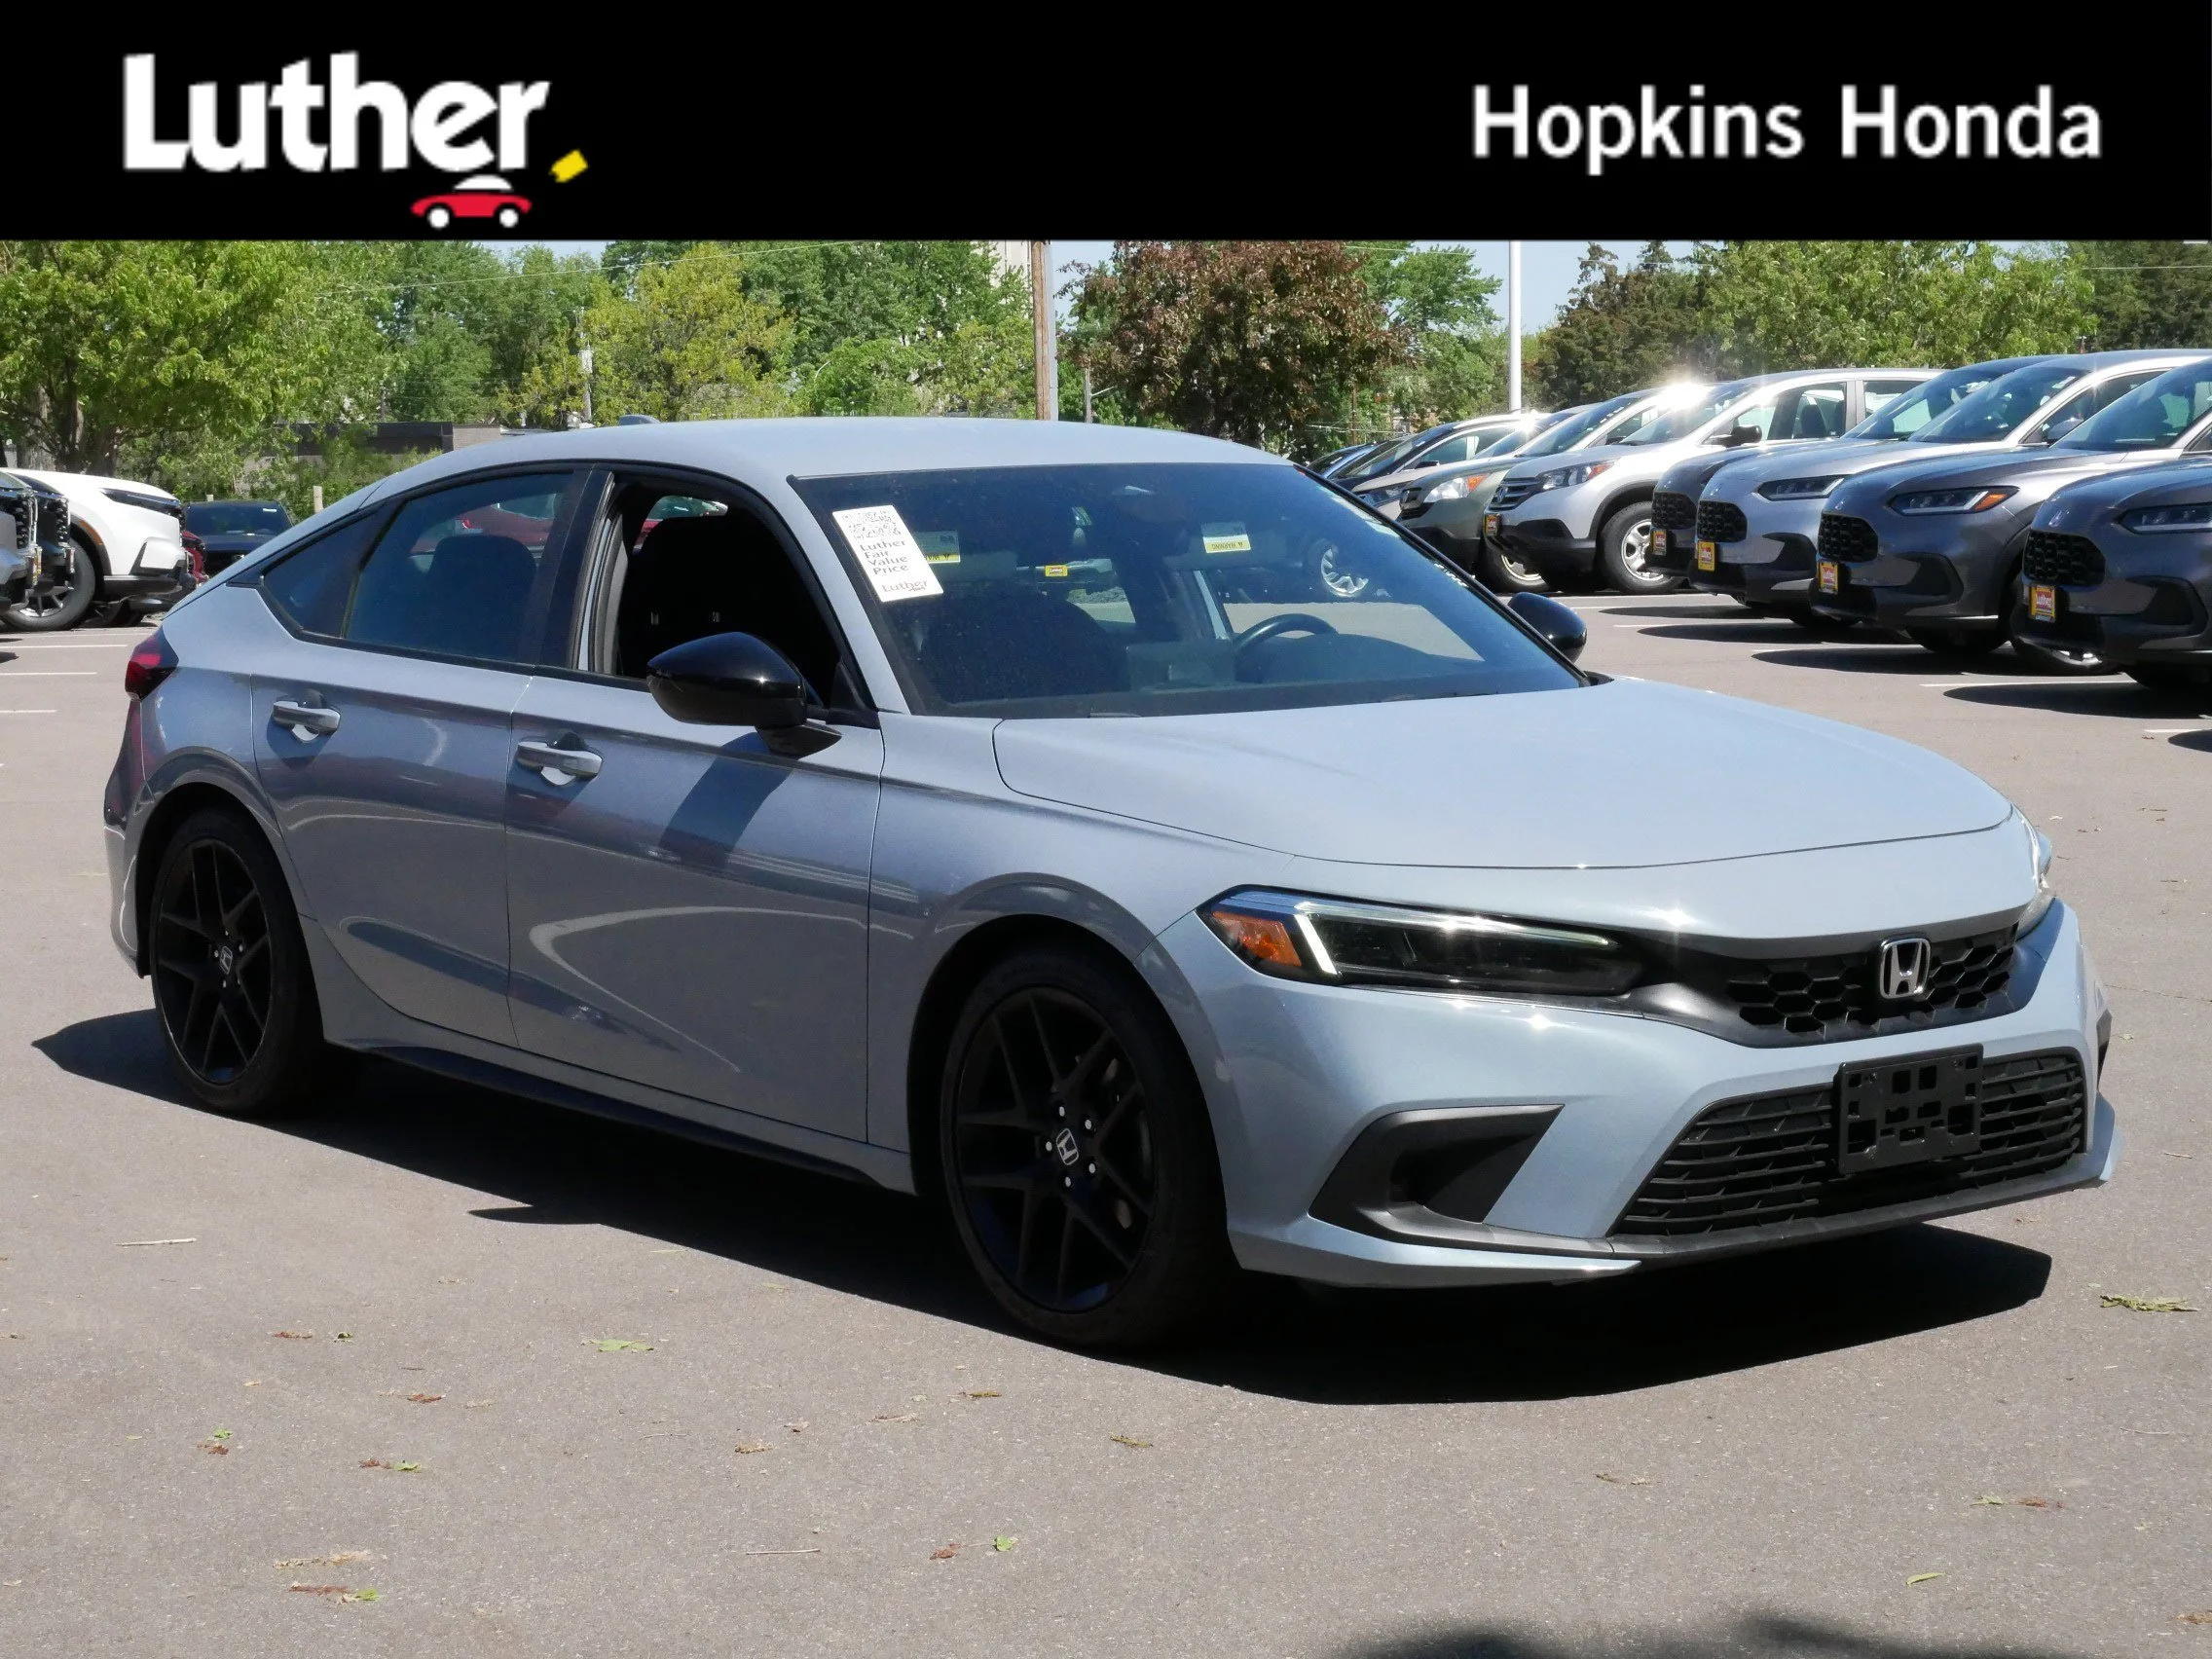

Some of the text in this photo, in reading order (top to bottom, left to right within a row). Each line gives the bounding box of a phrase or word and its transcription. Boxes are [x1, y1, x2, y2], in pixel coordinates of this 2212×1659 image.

[860, 540, 905, 551] Luther
[868, 556, 907, 566] Value
[873, 565, 908, 574] Price
[882, 580, 927, 592] Luther
